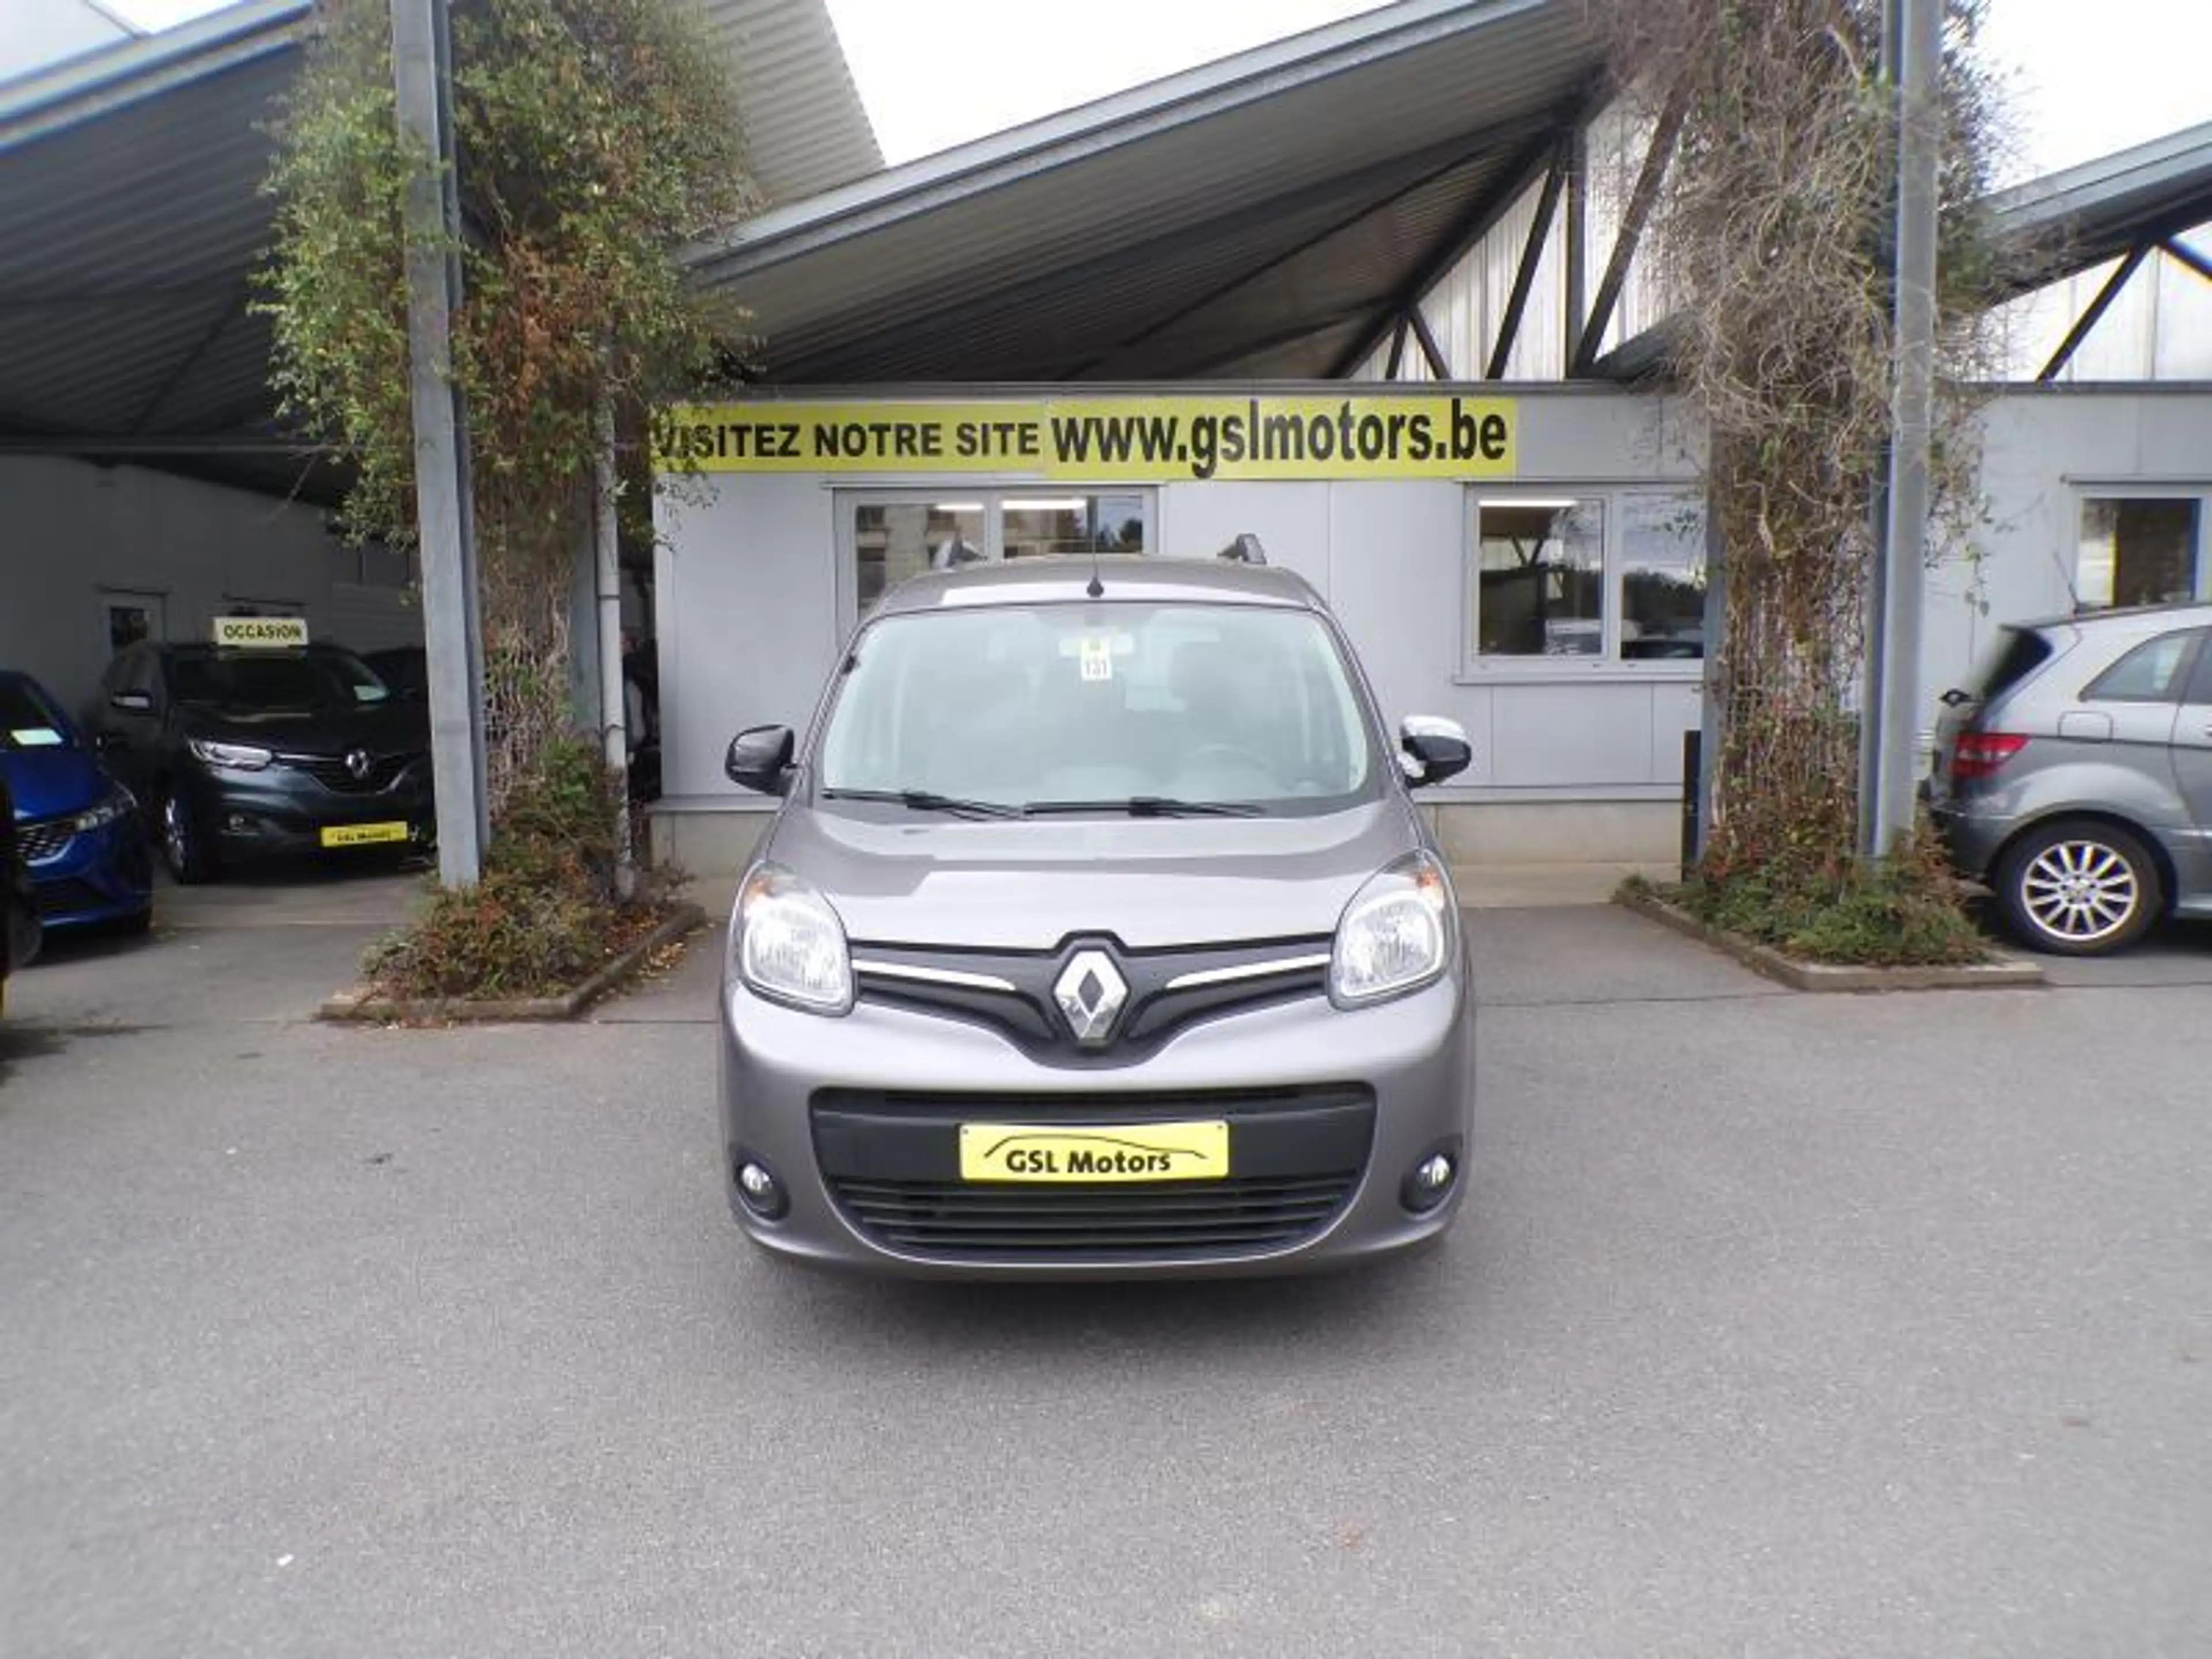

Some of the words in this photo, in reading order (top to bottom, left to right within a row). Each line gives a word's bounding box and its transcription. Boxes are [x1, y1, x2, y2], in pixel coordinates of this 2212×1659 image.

[655, 423, 801, 457] VISITEZ
[815, 422, 944, 457] NOTRE
[956, 422, 1040, 456] SITE
[1051, 398, 1506, 479] www.gslmotors.be
[224, 624, 302, 641] OCCASION
[1006, 1150, 1060, 1173] GSL
[1067, 1150, 1171, 1174] Motors
